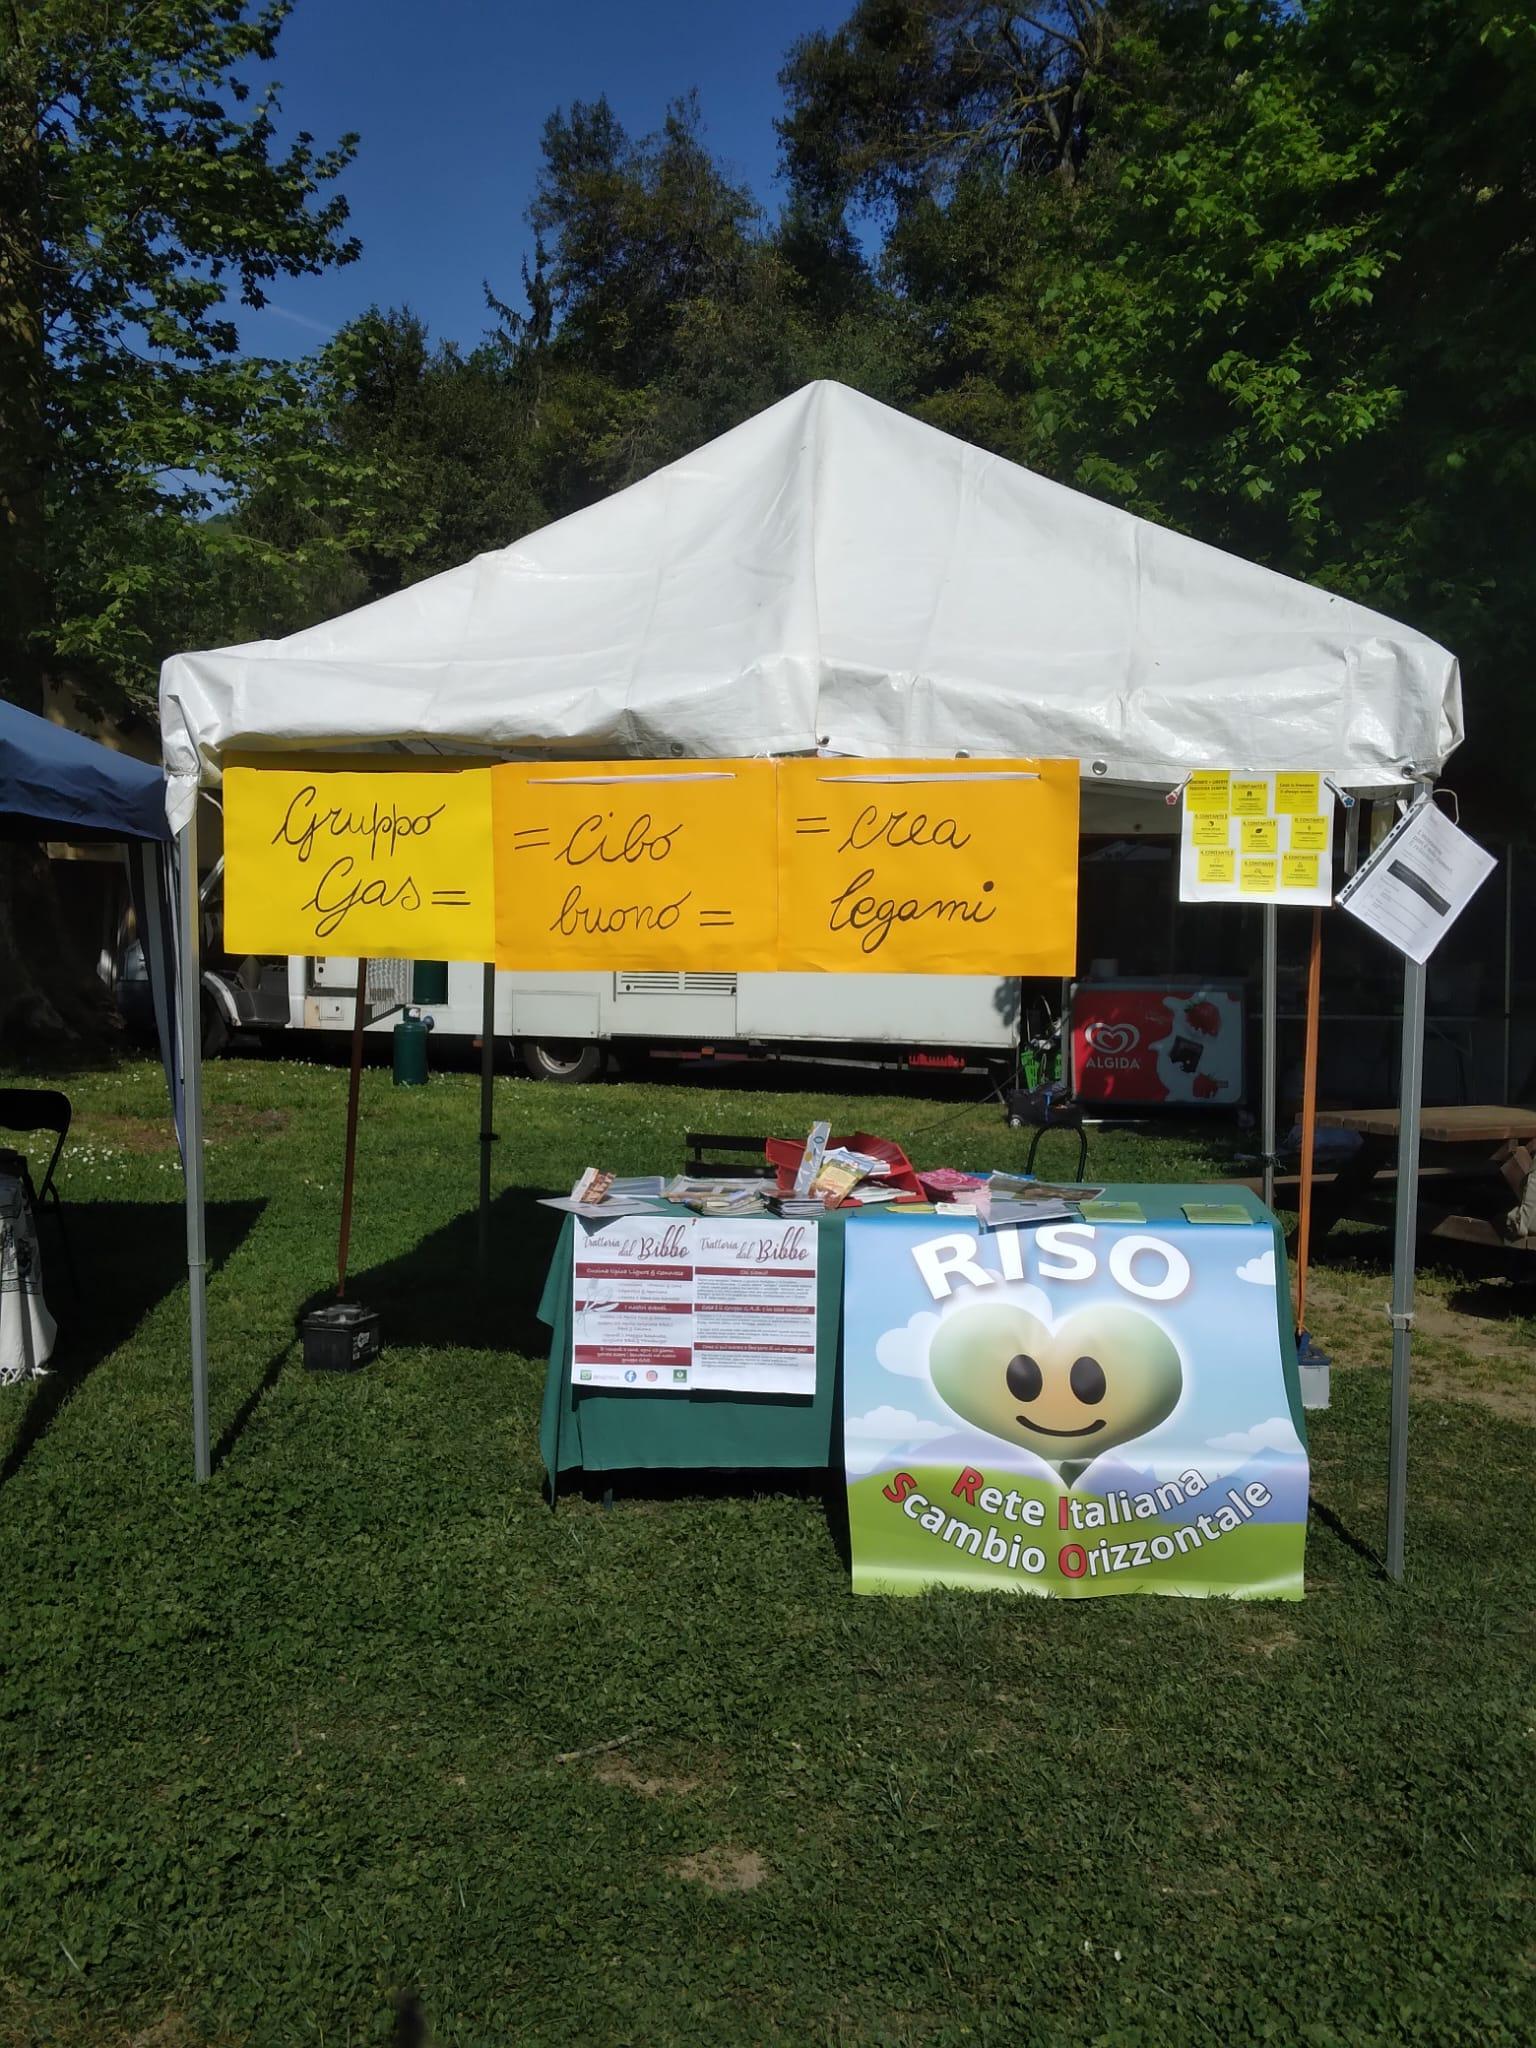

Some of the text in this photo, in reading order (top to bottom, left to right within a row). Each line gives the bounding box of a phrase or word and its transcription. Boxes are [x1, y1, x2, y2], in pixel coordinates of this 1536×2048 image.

[271, 785, 446, 862] Gruppo
[553, 811, 684, 866] Cibo
[301, 855, 421, 938] Gas
[549, 884, 692, 935] buono
[829, 867, 997, 954] legami
[1086, 1056, 1140, 1070] ALGIDA
[700, 1236, 739, 1251] Trattoria
[911, 1223, 1190, 1300] RISO
[882, 1472, 1273, 1580] Scambio Orizzontale
[951, 1466, 1210, 1531] Rete Italiana
